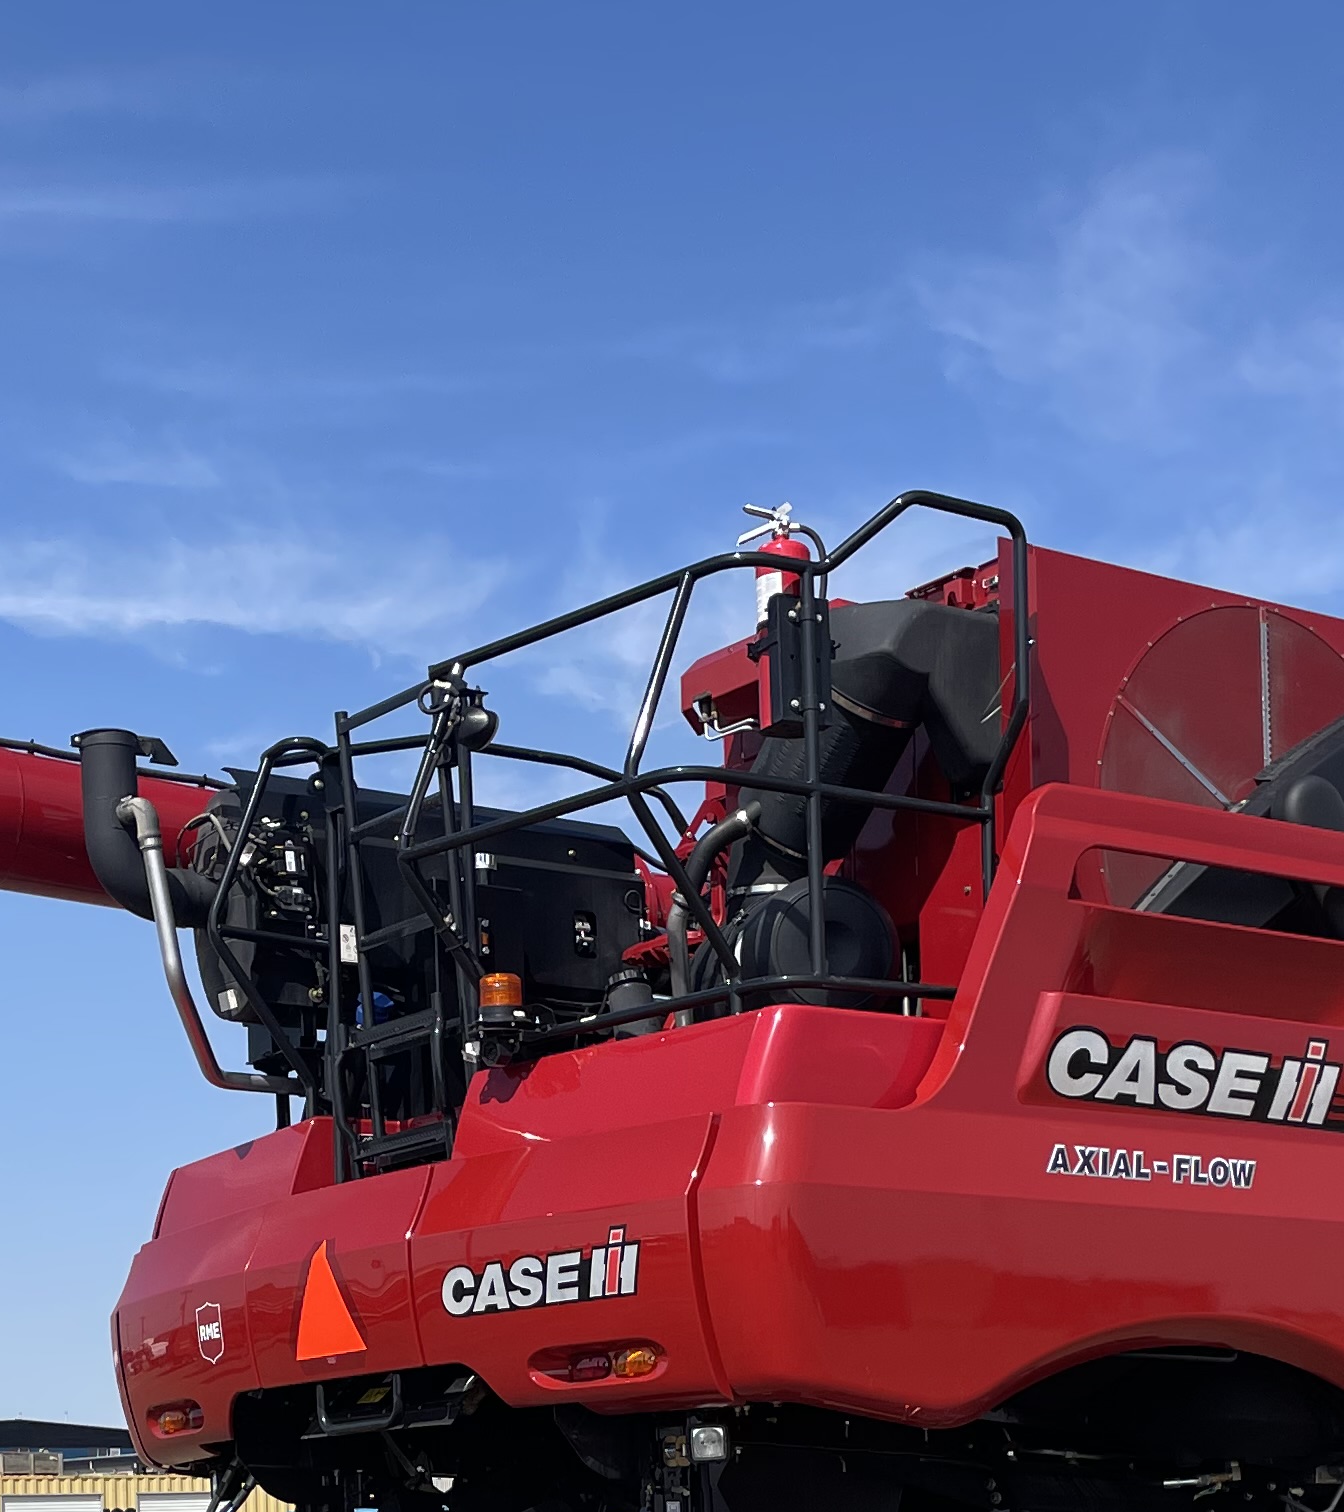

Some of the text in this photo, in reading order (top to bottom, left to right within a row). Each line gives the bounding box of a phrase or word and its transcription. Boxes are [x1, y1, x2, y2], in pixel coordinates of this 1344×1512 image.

[1047, 1029, 1270, 1118] CASE
[1046, 1143, 1257, 1189] AXIAL-FLOW
[441, 1250, 582, 1316] CASE
[199, 1321, 221, 1342] RME
